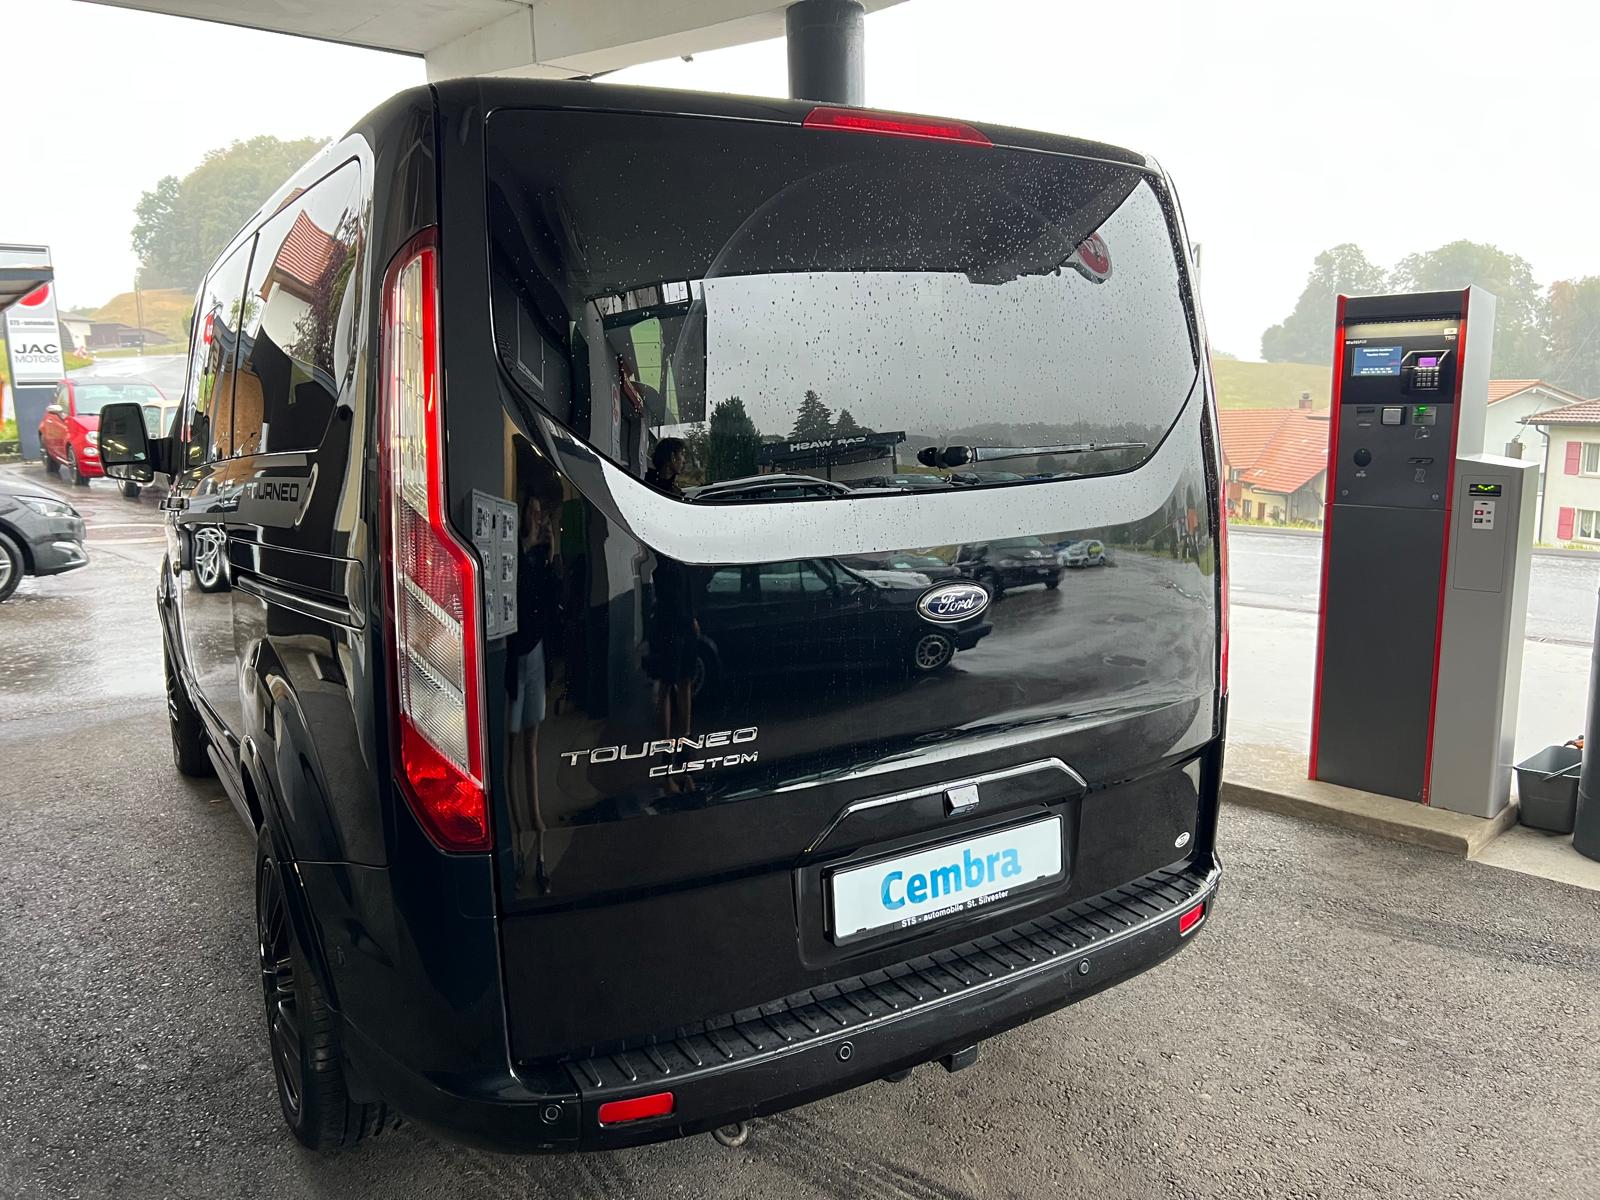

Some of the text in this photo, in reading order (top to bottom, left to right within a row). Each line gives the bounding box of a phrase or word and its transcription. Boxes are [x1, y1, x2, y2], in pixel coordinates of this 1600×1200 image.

[15, 344, 58, 354] JAC
[15, 355, 60, 363] MOTORS
[938, 592, 975, 613] Ford
[561, 726, 758, 766] TOURNEO
[649, 751, 759, 778] CUSTOM
[880, 848, 1022, 911] Cembra
[901, 917, 917, 928] STS
[923, 904, 963, 920] automobile
[966, 899, 977, 908] St.
[978, 890, 1008, 905] Silvester
